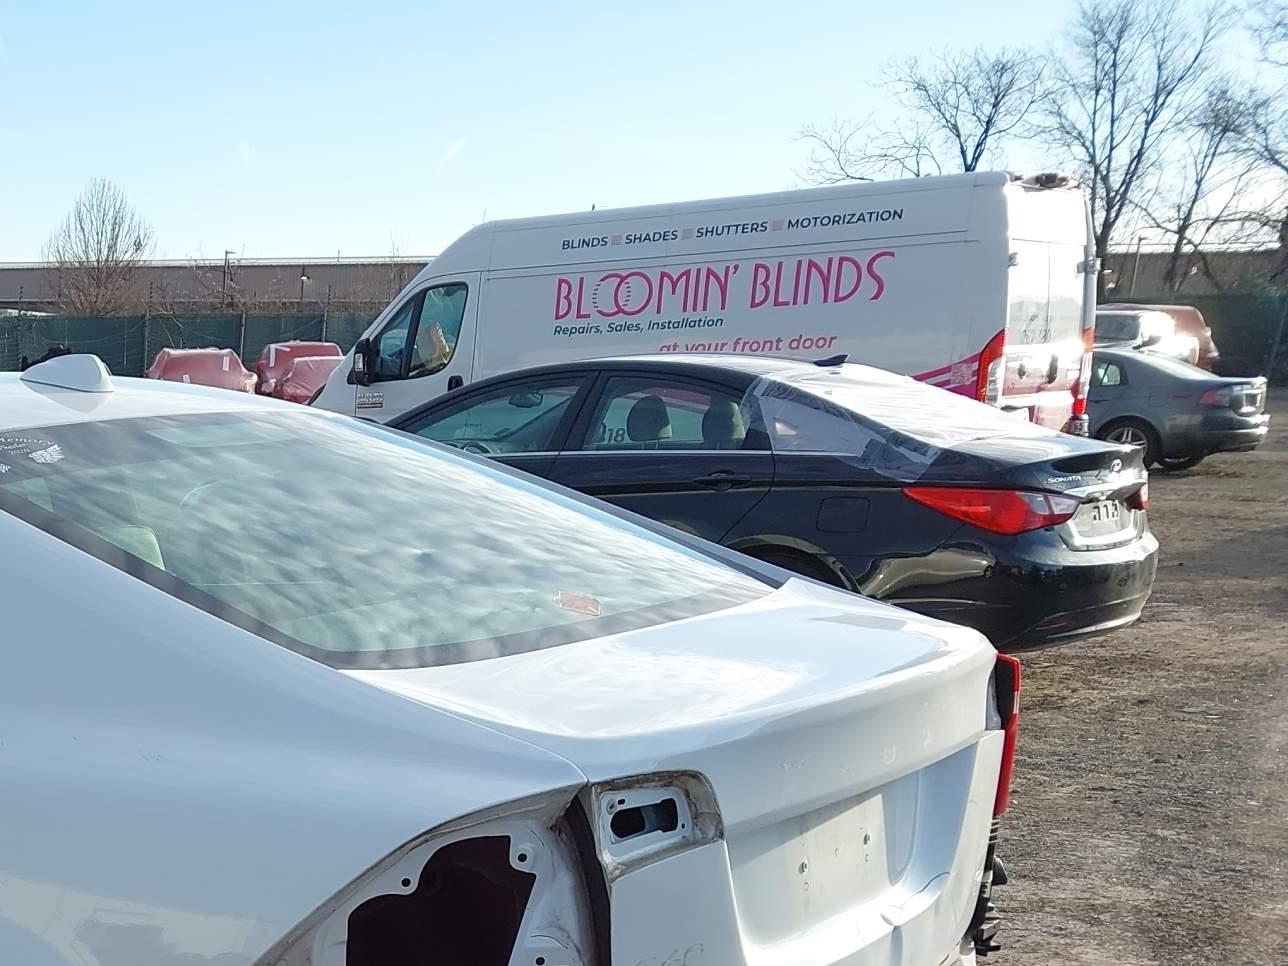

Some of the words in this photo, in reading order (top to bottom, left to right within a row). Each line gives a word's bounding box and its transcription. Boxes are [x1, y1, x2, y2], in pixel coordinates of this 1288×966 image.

[562, 236, 608, 250] BLINDS
[624, 230, 678, 245] SHADES
[696, 221, 768, 239] SHUTTERS
[787, 209, 904, 230] MOTORIZATION
[750, 251, 896, 309] BLINDS
[553, 323, 603, 337] Repairs,
[606, 320, 644, 333] Sales,
[647, 316, 724, 331] Installation
[733, 336, 783, 352] front
[788, 334, 838, 350] door
[1047, 475, 1081, 484] SONATA
